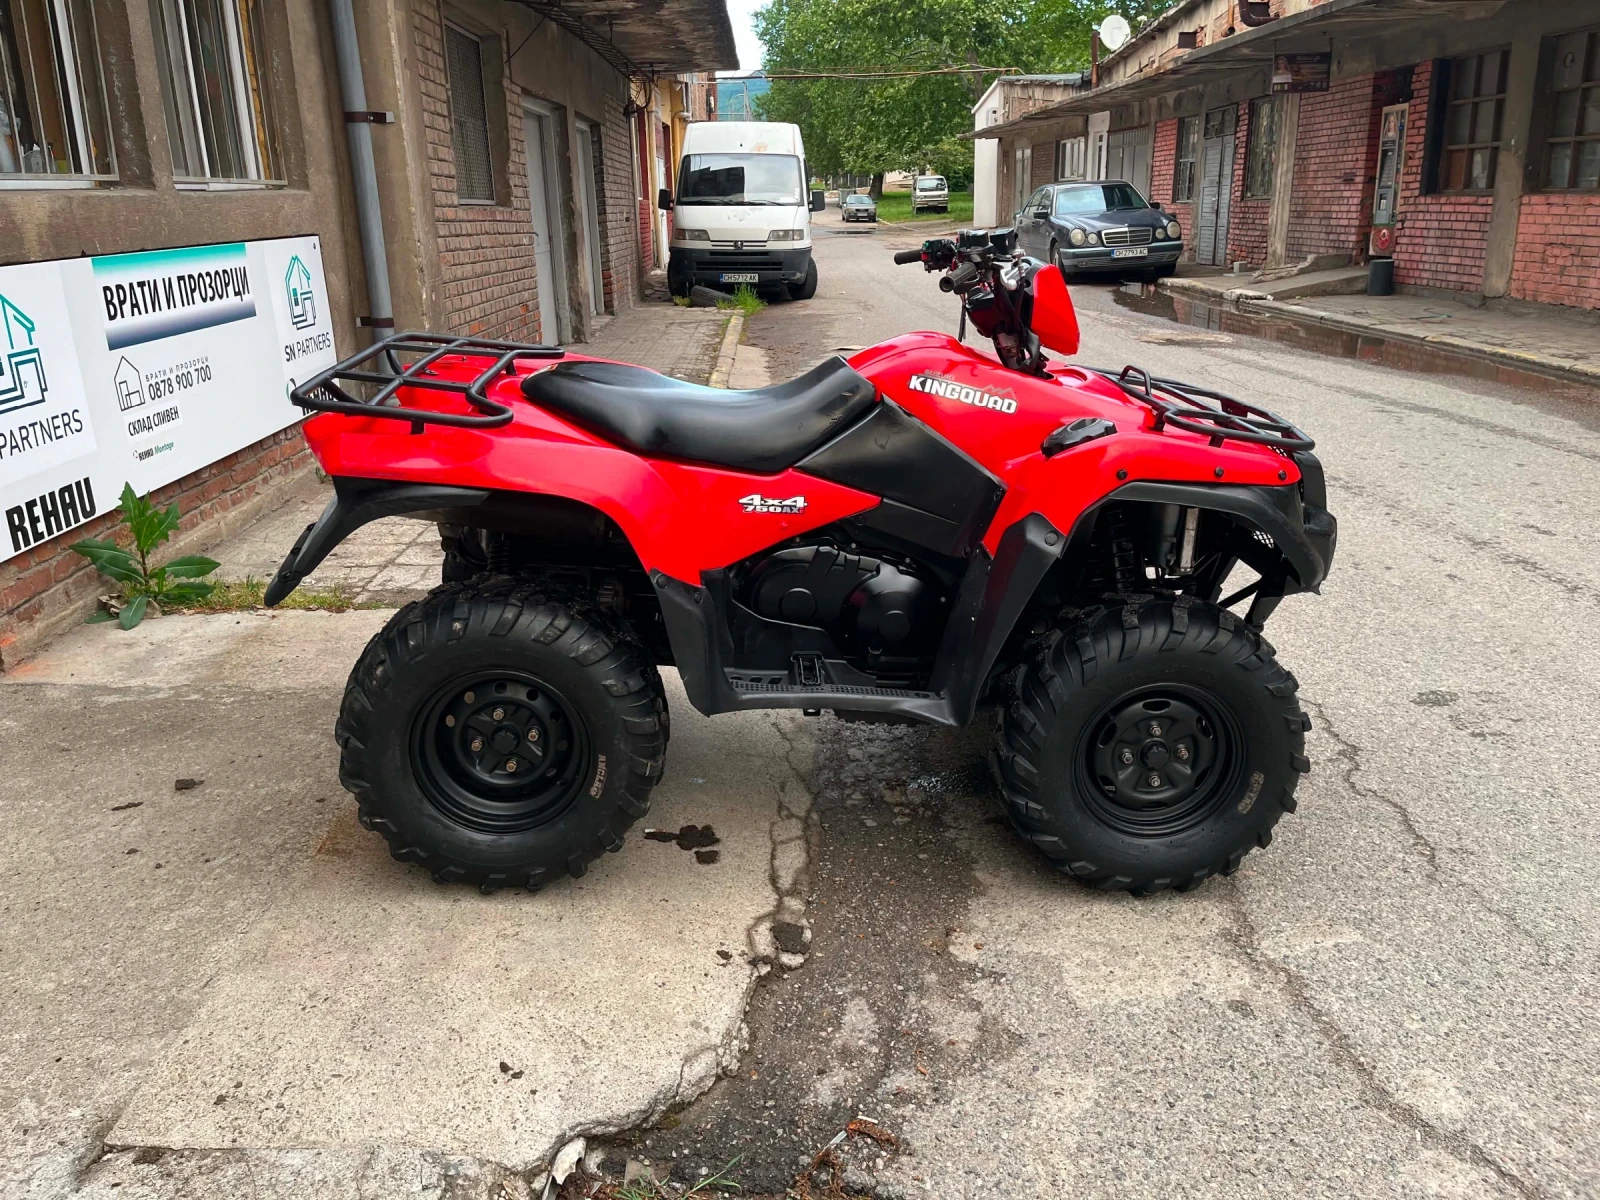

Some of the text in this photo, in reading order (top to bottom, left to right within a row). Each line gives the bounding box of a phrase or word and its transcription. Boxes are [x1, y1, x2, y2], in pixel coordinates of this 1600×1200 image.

[102, 266, 250, 321] ВРАТИ И ПРОЗОРЦИ
[284, 332, 331, 362] SN PARTNERS
[148, 364, 212, 401] 0878 900 700
[924, 369, 955, 380] SUZUKI
[908, 375, 1018, 414] KINGQUAD
[128, 406, 179, 436] СКЛАД СЛИВЕН
[154, 441, 174, 455] Montage
[5, 477, 97, 553] REHAU
[738, 494, 807, 508] 4x4
